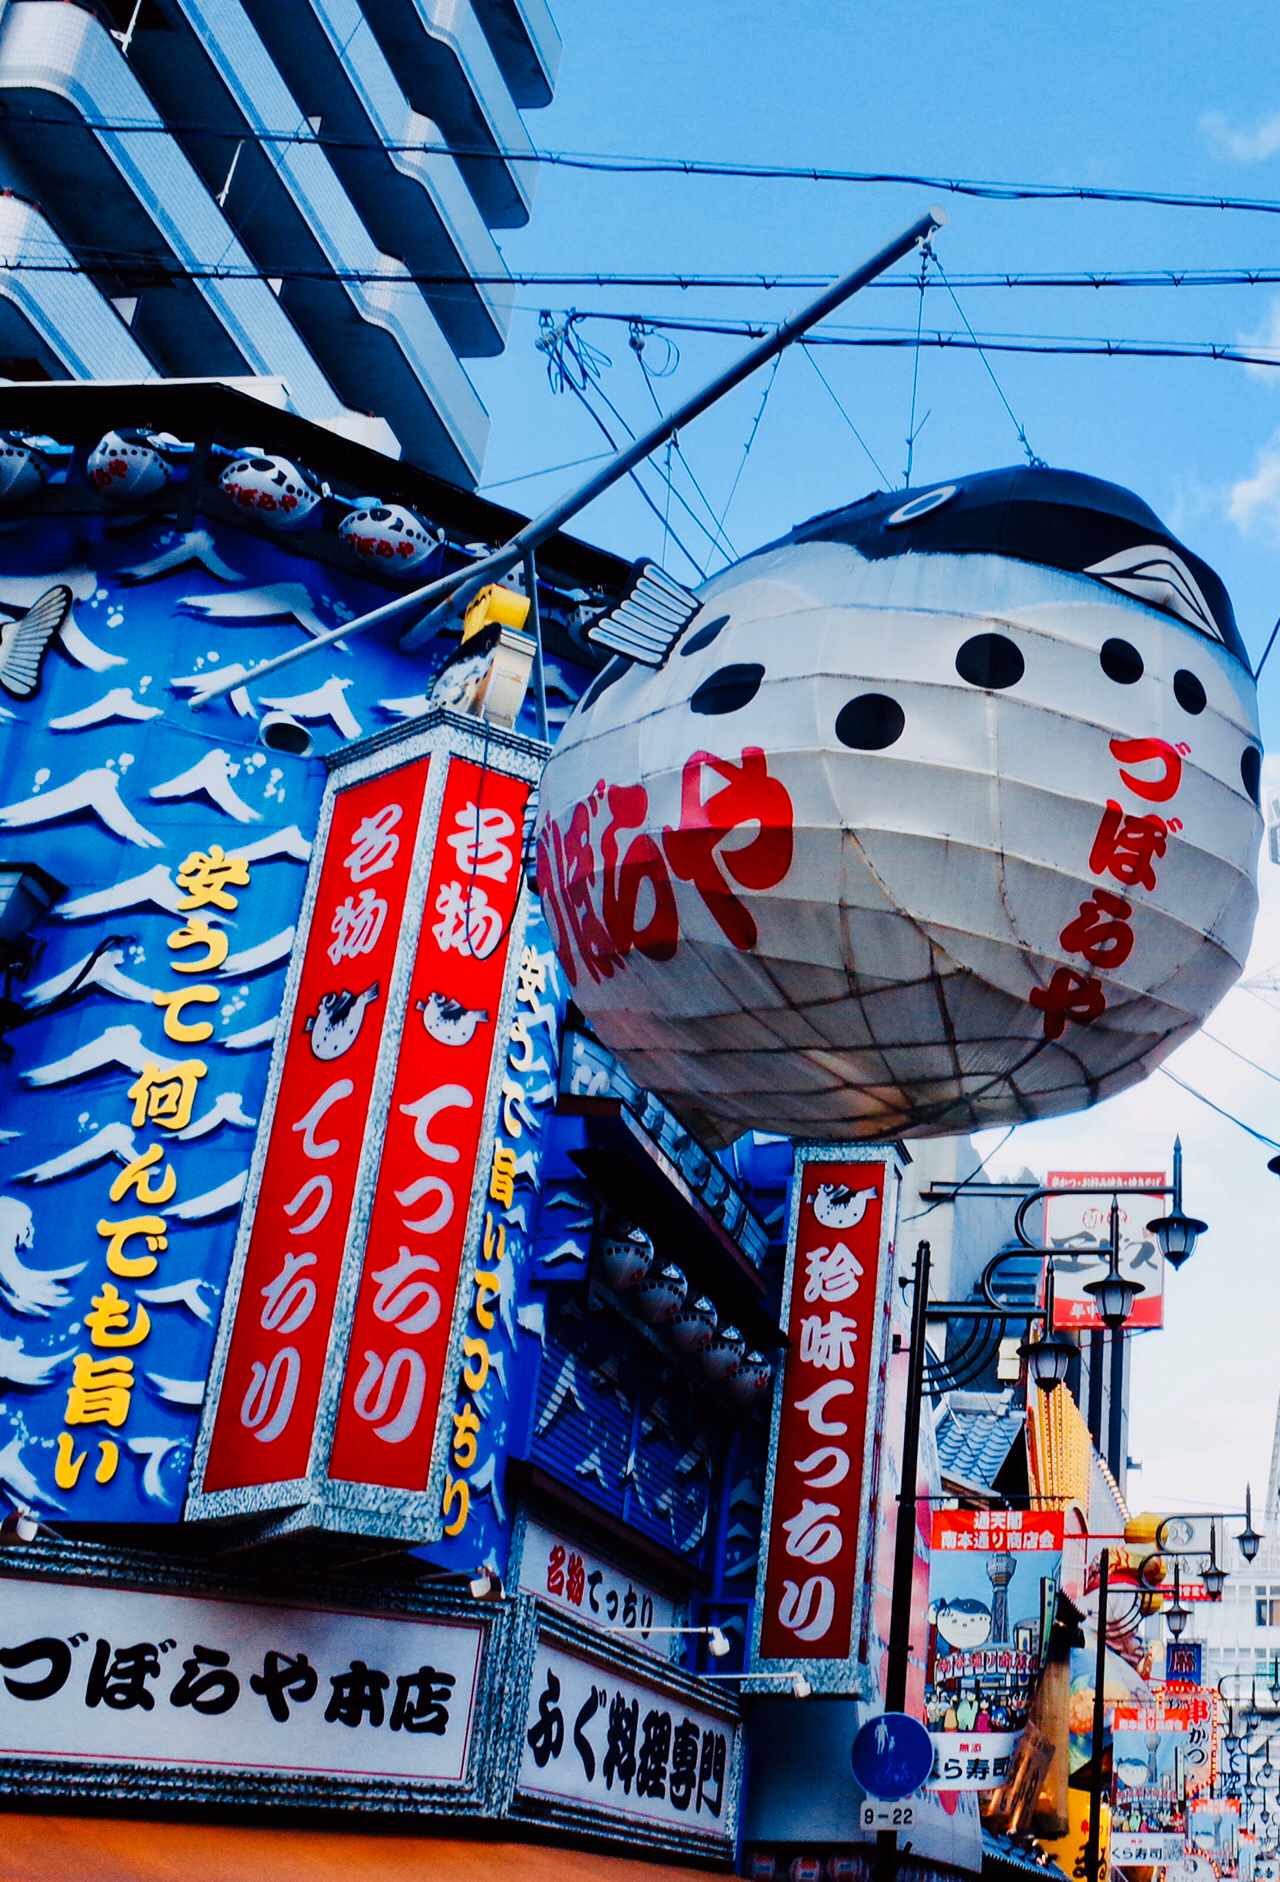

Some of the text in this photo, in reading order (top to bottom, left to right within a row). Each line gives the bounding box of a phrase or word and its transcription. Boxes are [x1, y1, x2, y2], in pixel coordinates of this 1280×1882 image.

[327, 803, 403, 965] 名物
[432, 801, 516, 962] 名物
[1030, 738, 1192, 1040] づぼらや
[54, 845, 250, 1489] 安うて何んでも旨い
[941, 1531, 1055, 1550] 南本通り商店会
[973, 1511, 1024, 1531] 通天閣
[3, 1632, 456, 1735] づぼらや本店
[527, 1668, 726, 1818] ふぐ料理専門
